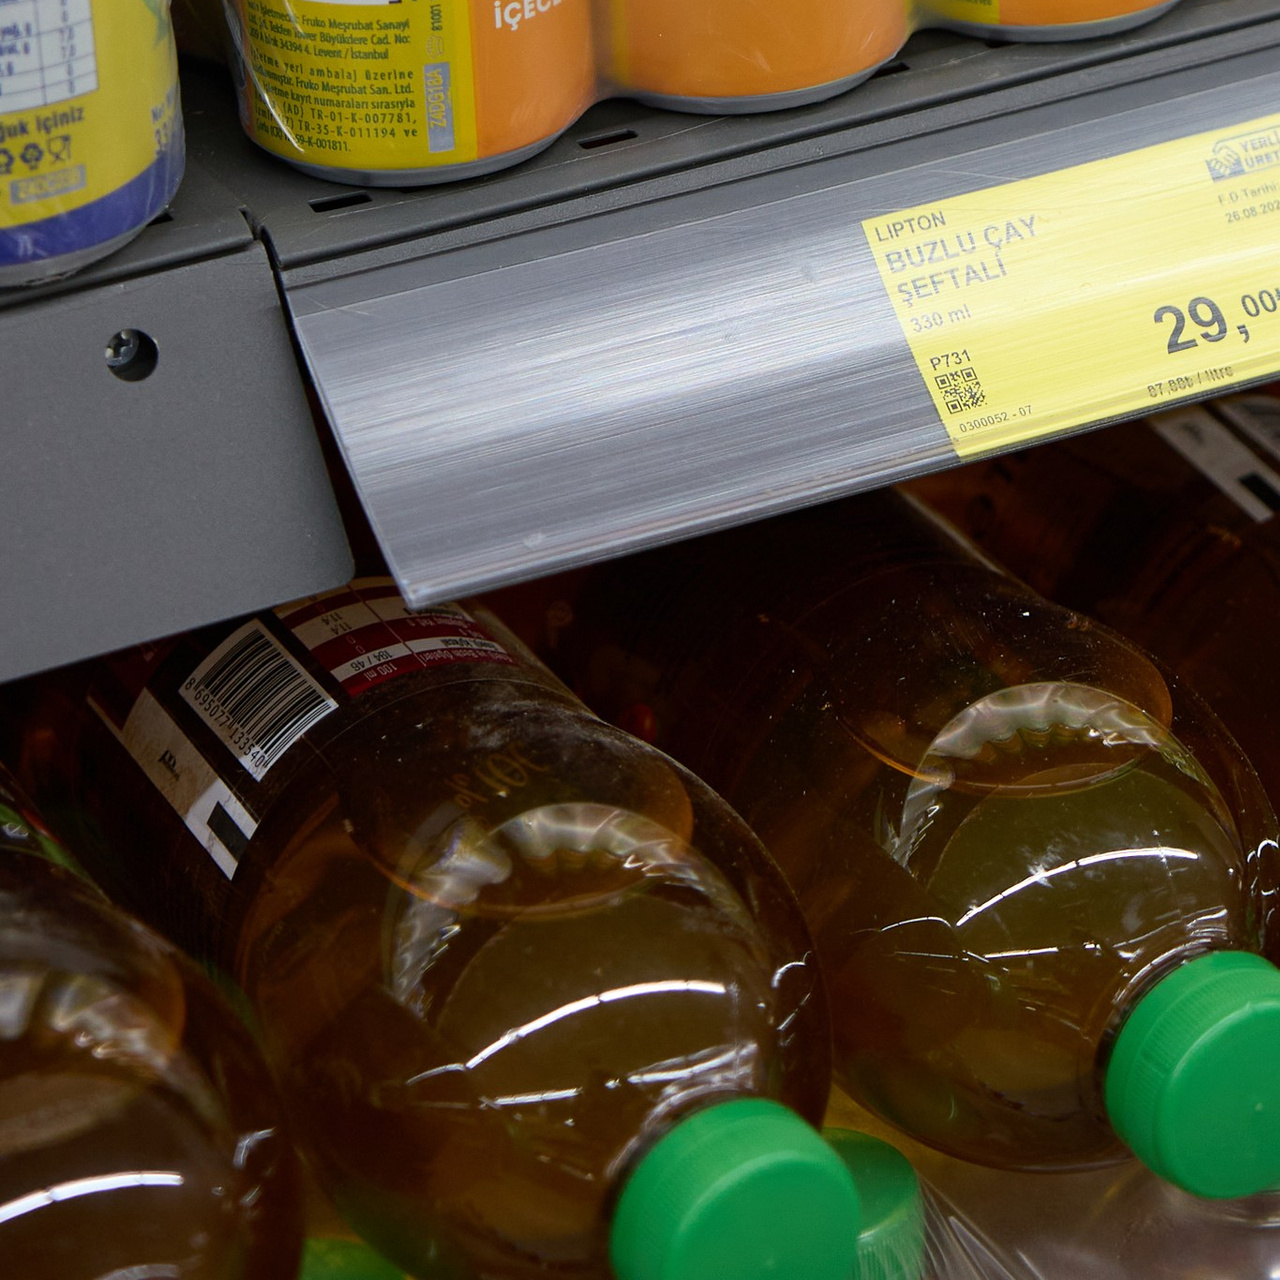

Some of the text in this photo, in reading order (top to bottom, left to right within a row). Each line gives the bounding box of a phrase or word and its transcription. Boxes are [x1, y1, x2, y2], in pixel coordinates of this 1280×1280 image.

[302, 15, 410, 33] Fruko Meşrubat Sanayi
[430, 3, 444, 32] 81001
[309, 67, 414, 82] ambalaj üzerine
[404, 127, 419, 138] ve
[874, 210, 947, 244] LIPTON
[885, 213, 1039, 277] BUZLU ÇAY
[895, 255, 1009, 310] ŞEFTALİ
[909, 303, 972, 335] 330 ml
[929, 348, 973, 373] P731
[957, 411, 1011, 436] 0300052
[376, 664, 398, 678] 100
[185, 678, 267, 768] 8 695077 133540
